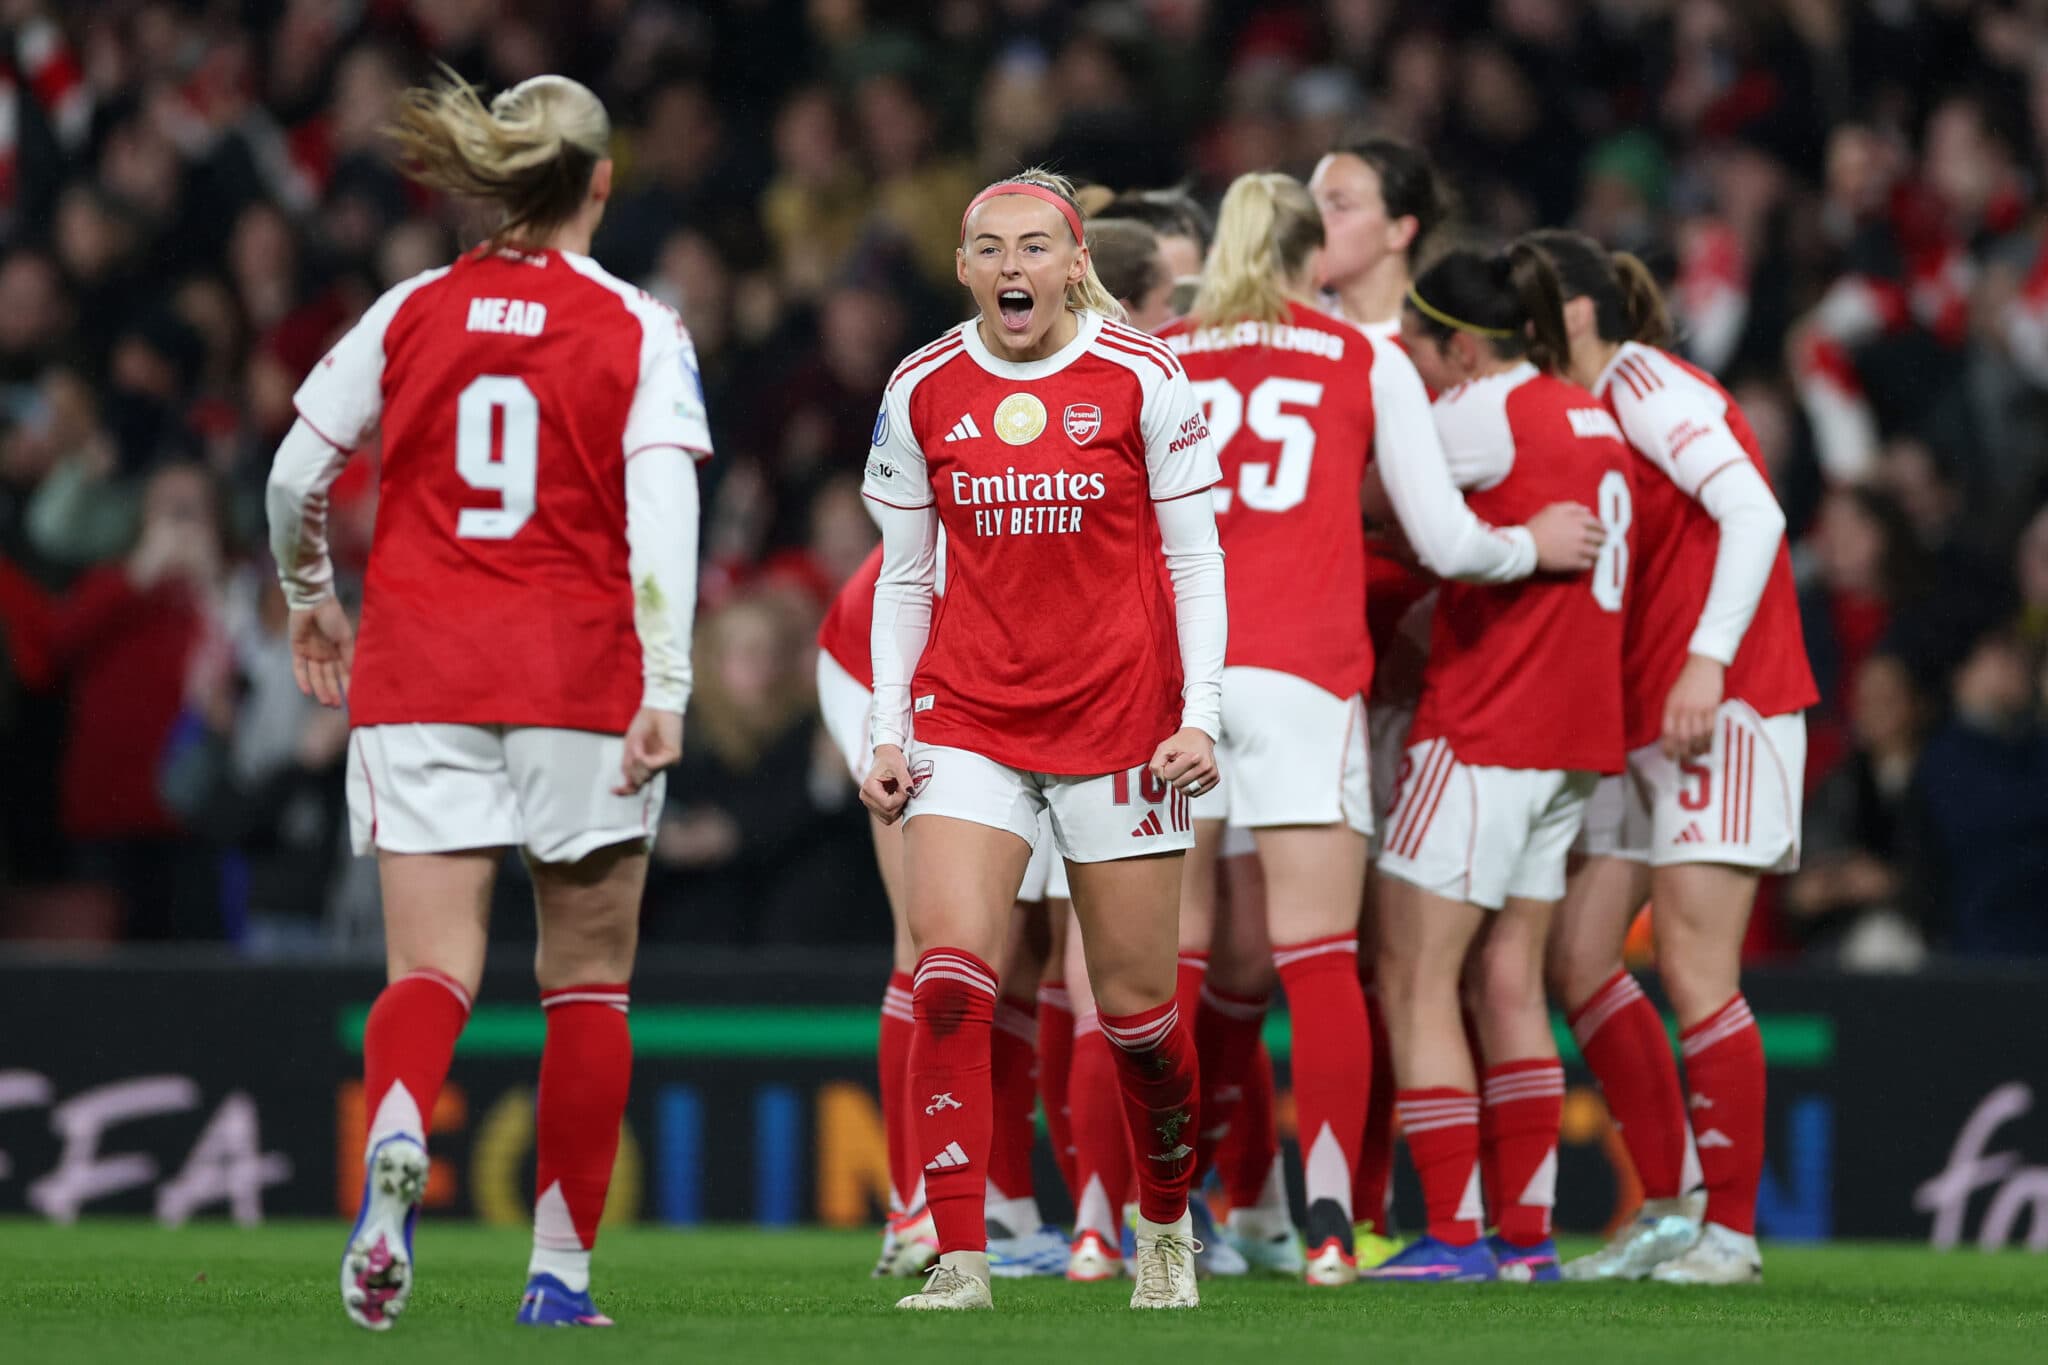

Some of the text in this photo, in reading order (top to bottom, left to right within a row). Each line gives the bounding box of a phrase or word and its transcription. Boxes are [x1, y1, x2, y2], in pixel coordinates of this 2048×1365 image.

[466, 297, 547, 337] MEAD
[1069, 410, 1097, 418] Arsenal
[456, 373, 540, 540] 9
[1169, 425, 1211, 454] RWAND
[1190, 376, 1325, 513] 25
[951, 466, 1106, 505] Emirates
[975, 506, 1083, 537] FLY BETTER
[1592, 469, 1632, 612] 8
